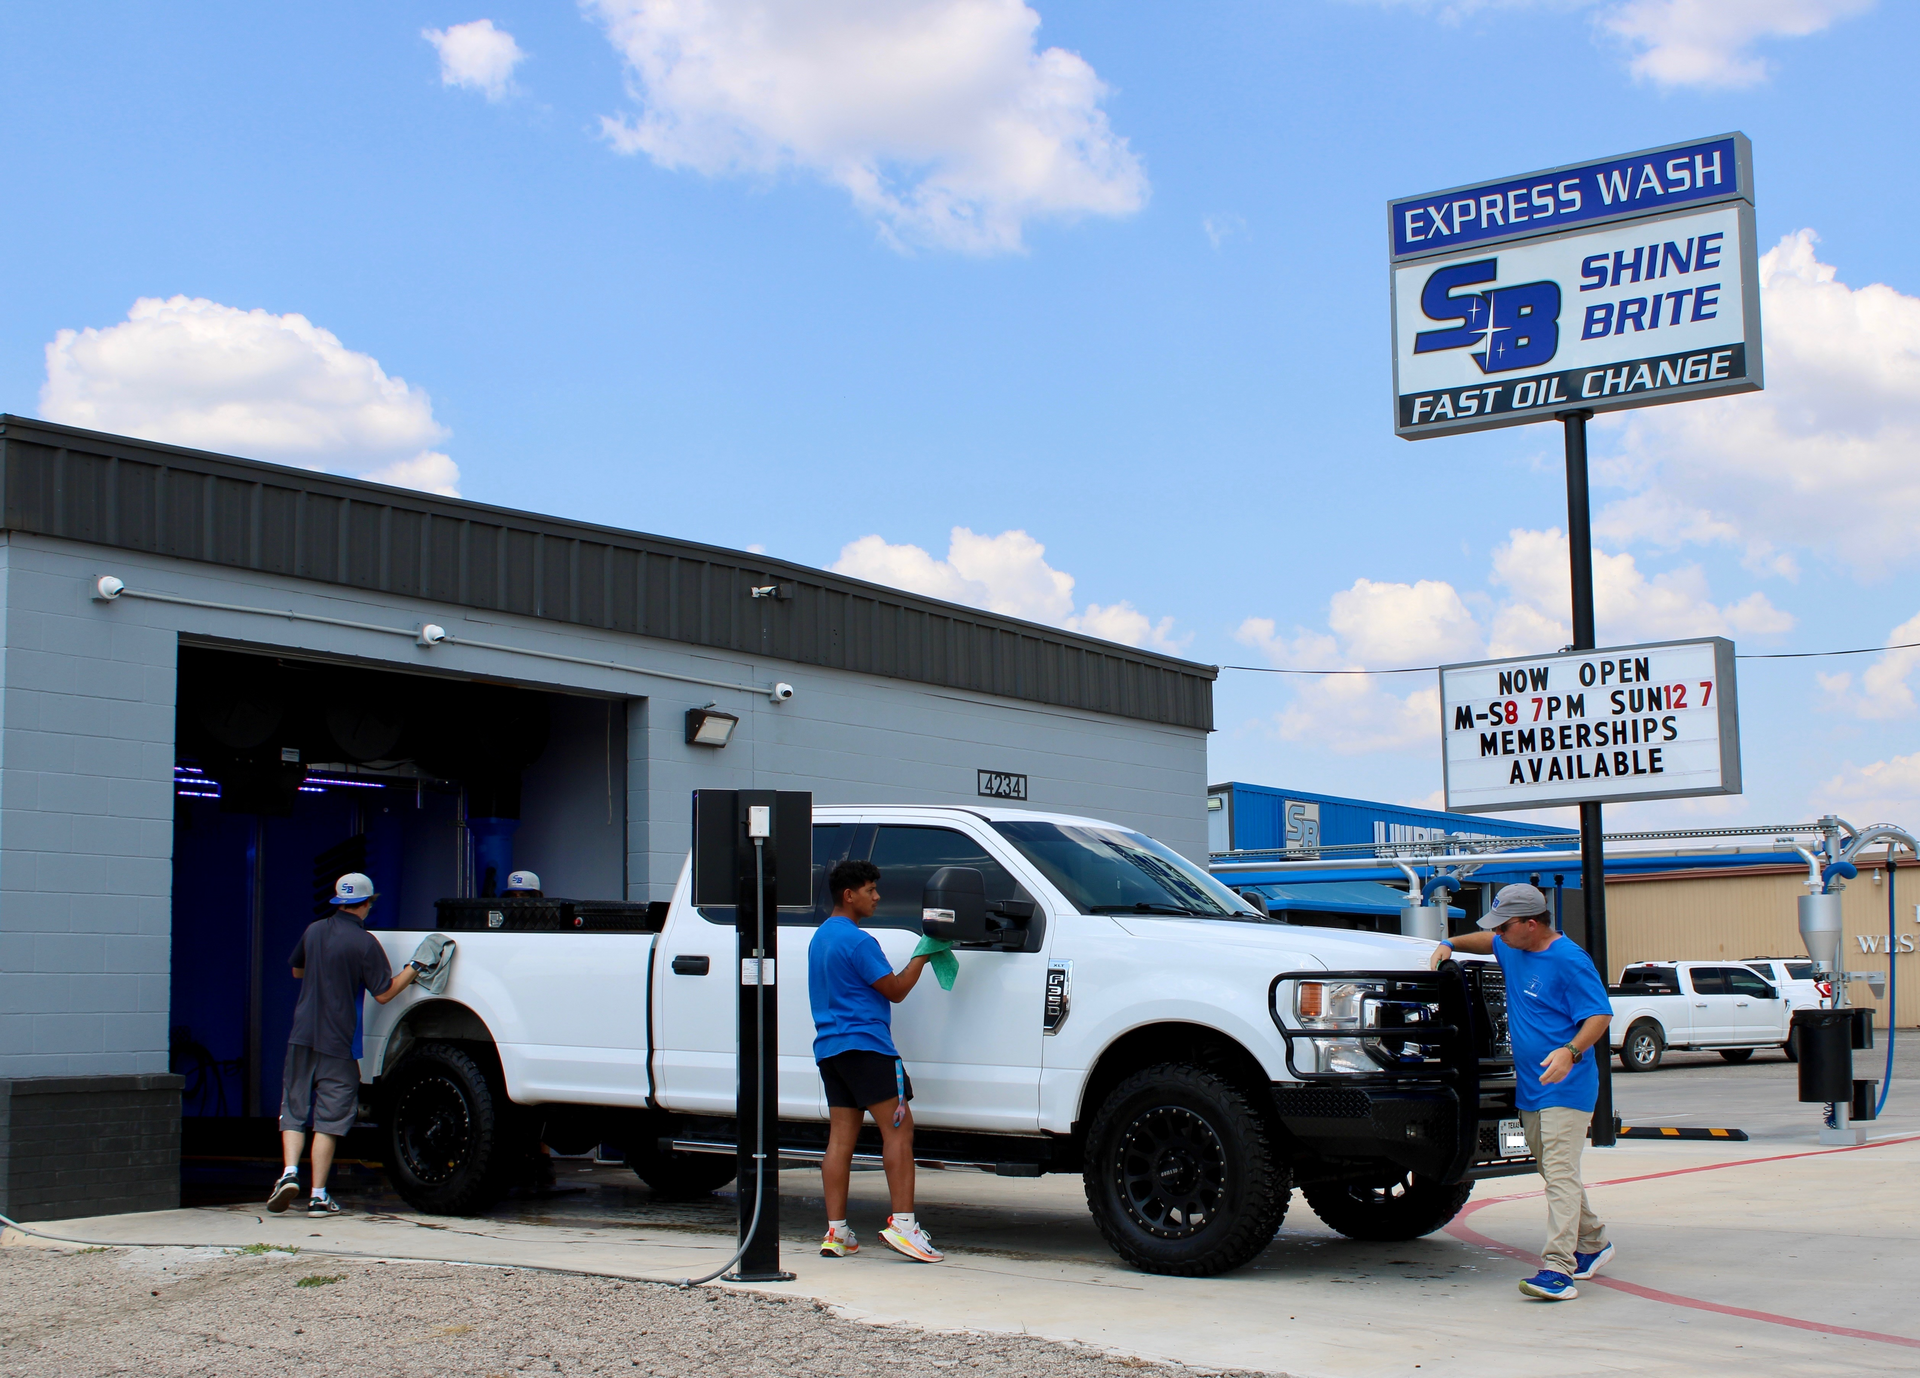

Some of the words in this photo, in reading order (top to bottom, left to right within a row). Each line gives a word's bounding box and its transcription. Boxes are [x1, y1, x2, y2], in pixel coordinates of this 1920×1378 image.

[1404, 178, 1581, 243] EXPRESS
[1596, 150, 1722, 206] WASH
[1579, 231, 1724, 292] SHINE
[1413, 257, 1561, 375] SB
[1580, 283, 1721, 341] BRITE
[1411, 387, 1502, 424] FAST
[1511, 377, 1567, 409] OIL
[1581, 350, 1733, 398] CHANGE
[1499, 666, 1549, 696] NOW
[1579, 656, 1650, 687] OPEN
[1699, 680, 1713, 707] 7
[1480, 715, 1678, 757] MEMBERSHIPS
[984, 773, 1022, 798] 4234
[1509, 747, 1664, 785] AVAILABLE
[341, 882, 354, 894] SB
[1047, 974, 1065, 1016] F350
